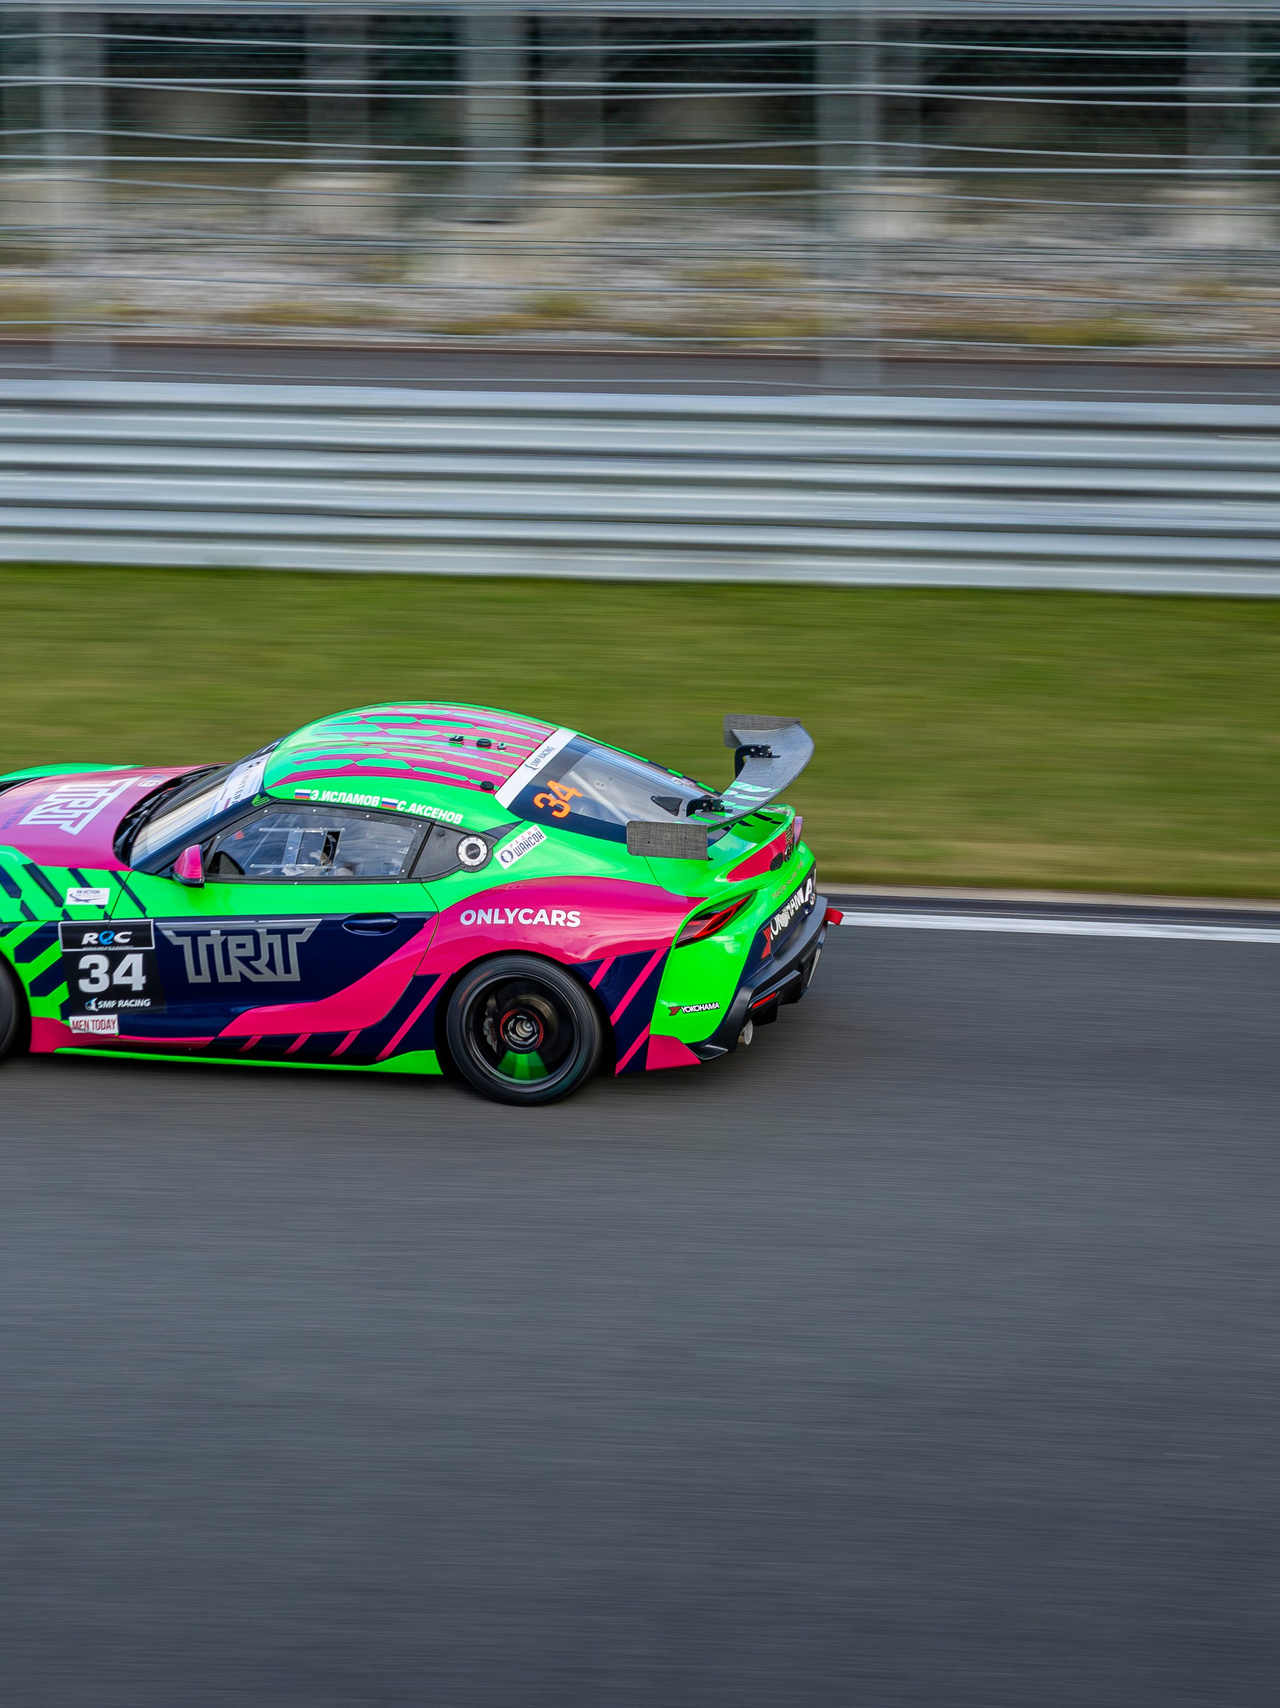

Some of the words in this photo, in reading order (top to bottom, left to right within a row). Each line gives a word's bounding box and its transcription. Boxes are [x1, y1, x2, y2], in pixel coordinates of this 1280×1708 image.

[310, 790, 380, 807] Э.ИСЛАМОВ
[396, 800, 464, 825] С.АКСЕНОВ
[533, 780, 583, 818] 34
[513, 830, 545, 857] ШАНСОН
[460, 908, 581, 928] ONLYCARS
[78, 953, 147, 993] 34
[97, 1000, 117, 1009] SMP
[117, 998, 151, 1008] RACING
[681, 1002, 720, 1013] YOKOHAMA
[72, 1020, 90, 1031] MEN
[91, 1018, 116, 1031] TODAY
